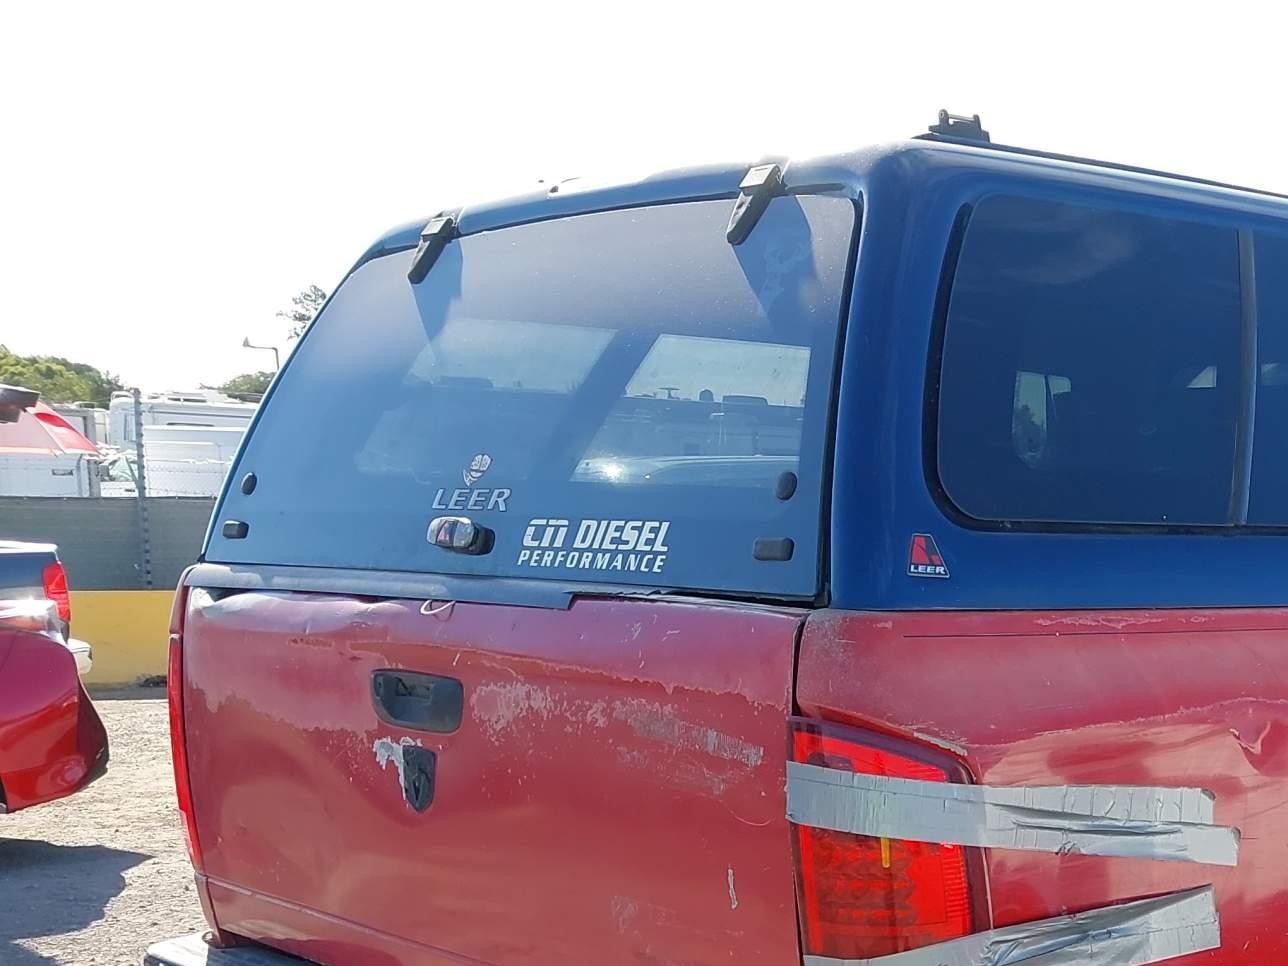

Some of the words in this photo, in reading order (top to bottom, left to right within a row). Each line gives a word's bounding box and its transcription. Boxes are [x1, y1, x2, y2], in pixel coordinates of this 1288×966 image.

[431, 488, 512, 512] LEER
[573, 519, 671, 552] DIESEL
[517, 549, 667, 573] PERFORMANCE
[910, 564, 946, 574] LEER
